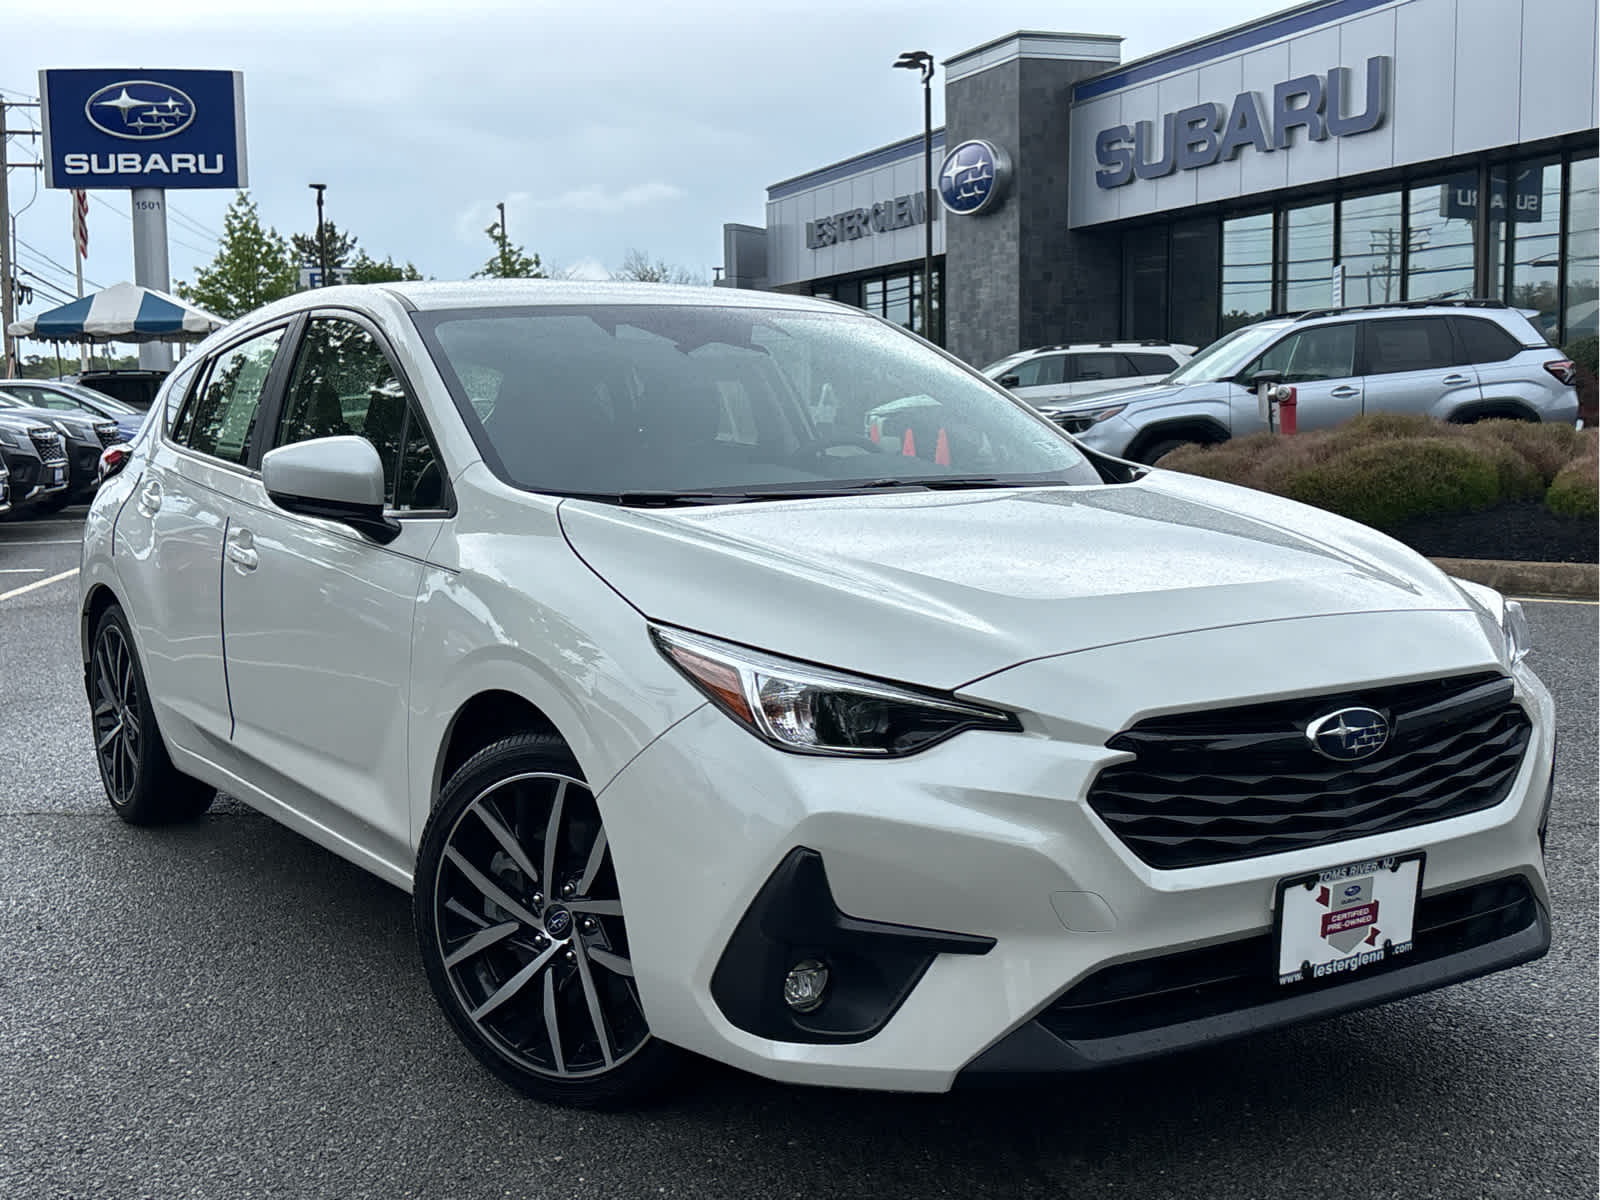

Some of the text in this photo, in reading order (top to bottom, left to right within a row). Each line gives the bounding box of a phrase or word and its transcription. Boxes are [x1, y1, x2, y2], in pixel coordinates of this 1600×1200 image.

[1095, 55, 1392, 190] SUBARU
[65, 153, 224, 175] SUBARU
[136, 201, 161, 211] 1501
[806, 208, 871, 250] LESTER
[1319, 868, 1348, 883] TOMS
[1382, 857, 1395, 869] NJ
[1327, 915, 1373, 930] PRE-OWNED
[1331, 907, 1370, 922] CERTIFIED
